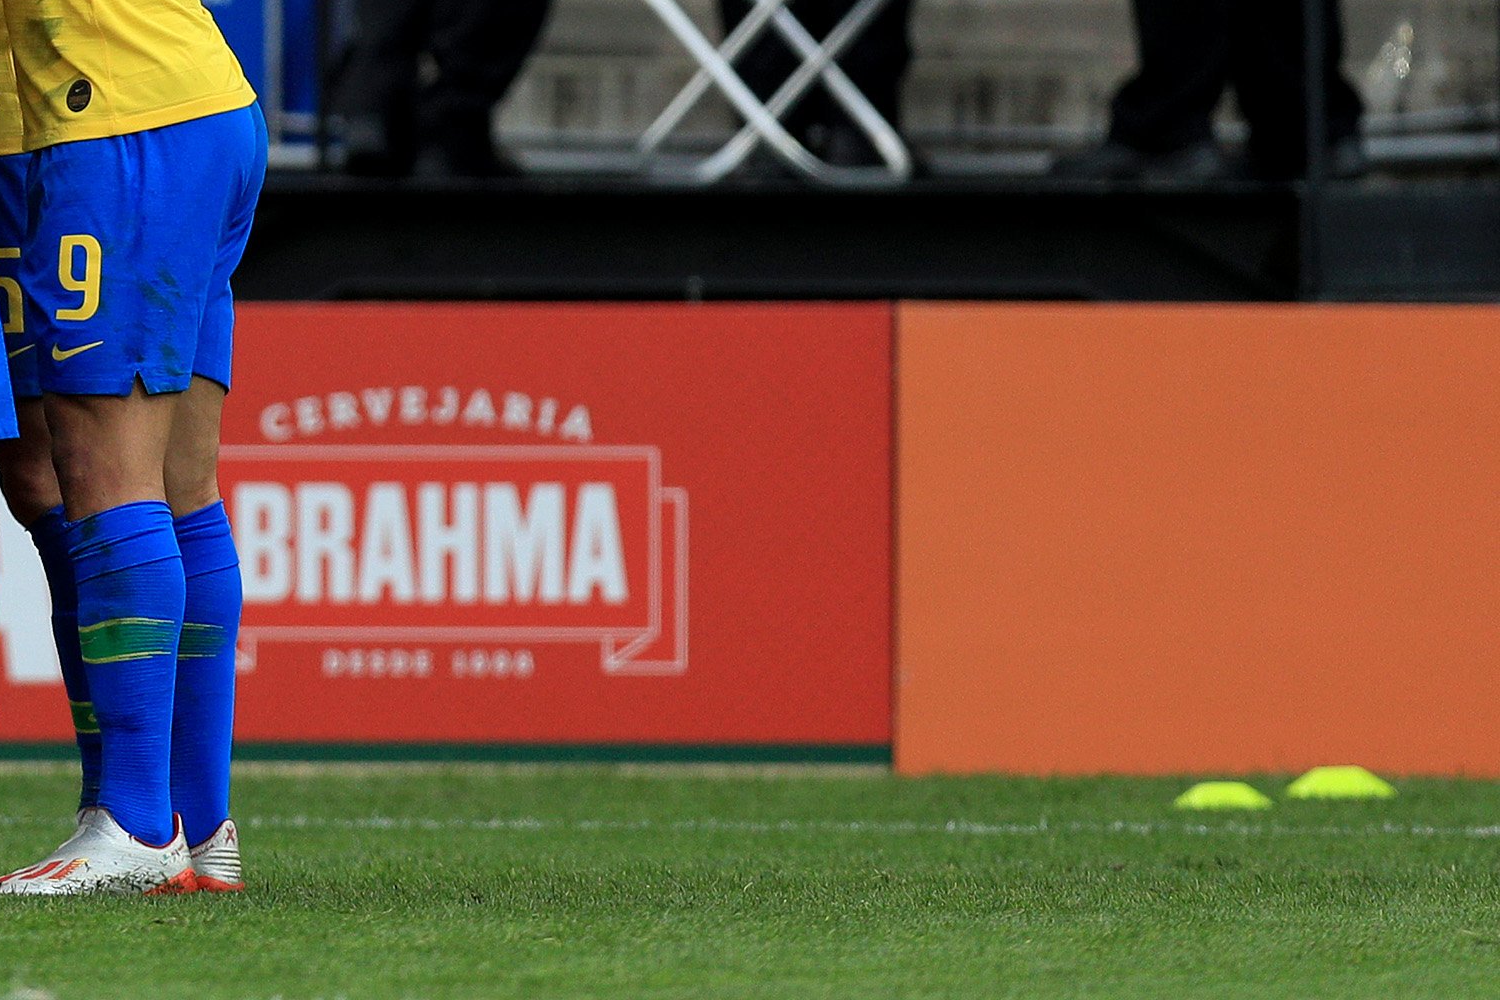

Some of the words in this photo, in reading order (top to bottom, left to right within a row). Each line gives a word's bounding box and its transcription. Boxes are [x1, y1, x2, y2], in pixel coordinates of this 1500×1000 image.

[56, 234, 102, 321] 9
[259, 385, 594, 443] CERVEJARIA
[234, 481, 629, 606] BRAHMA
